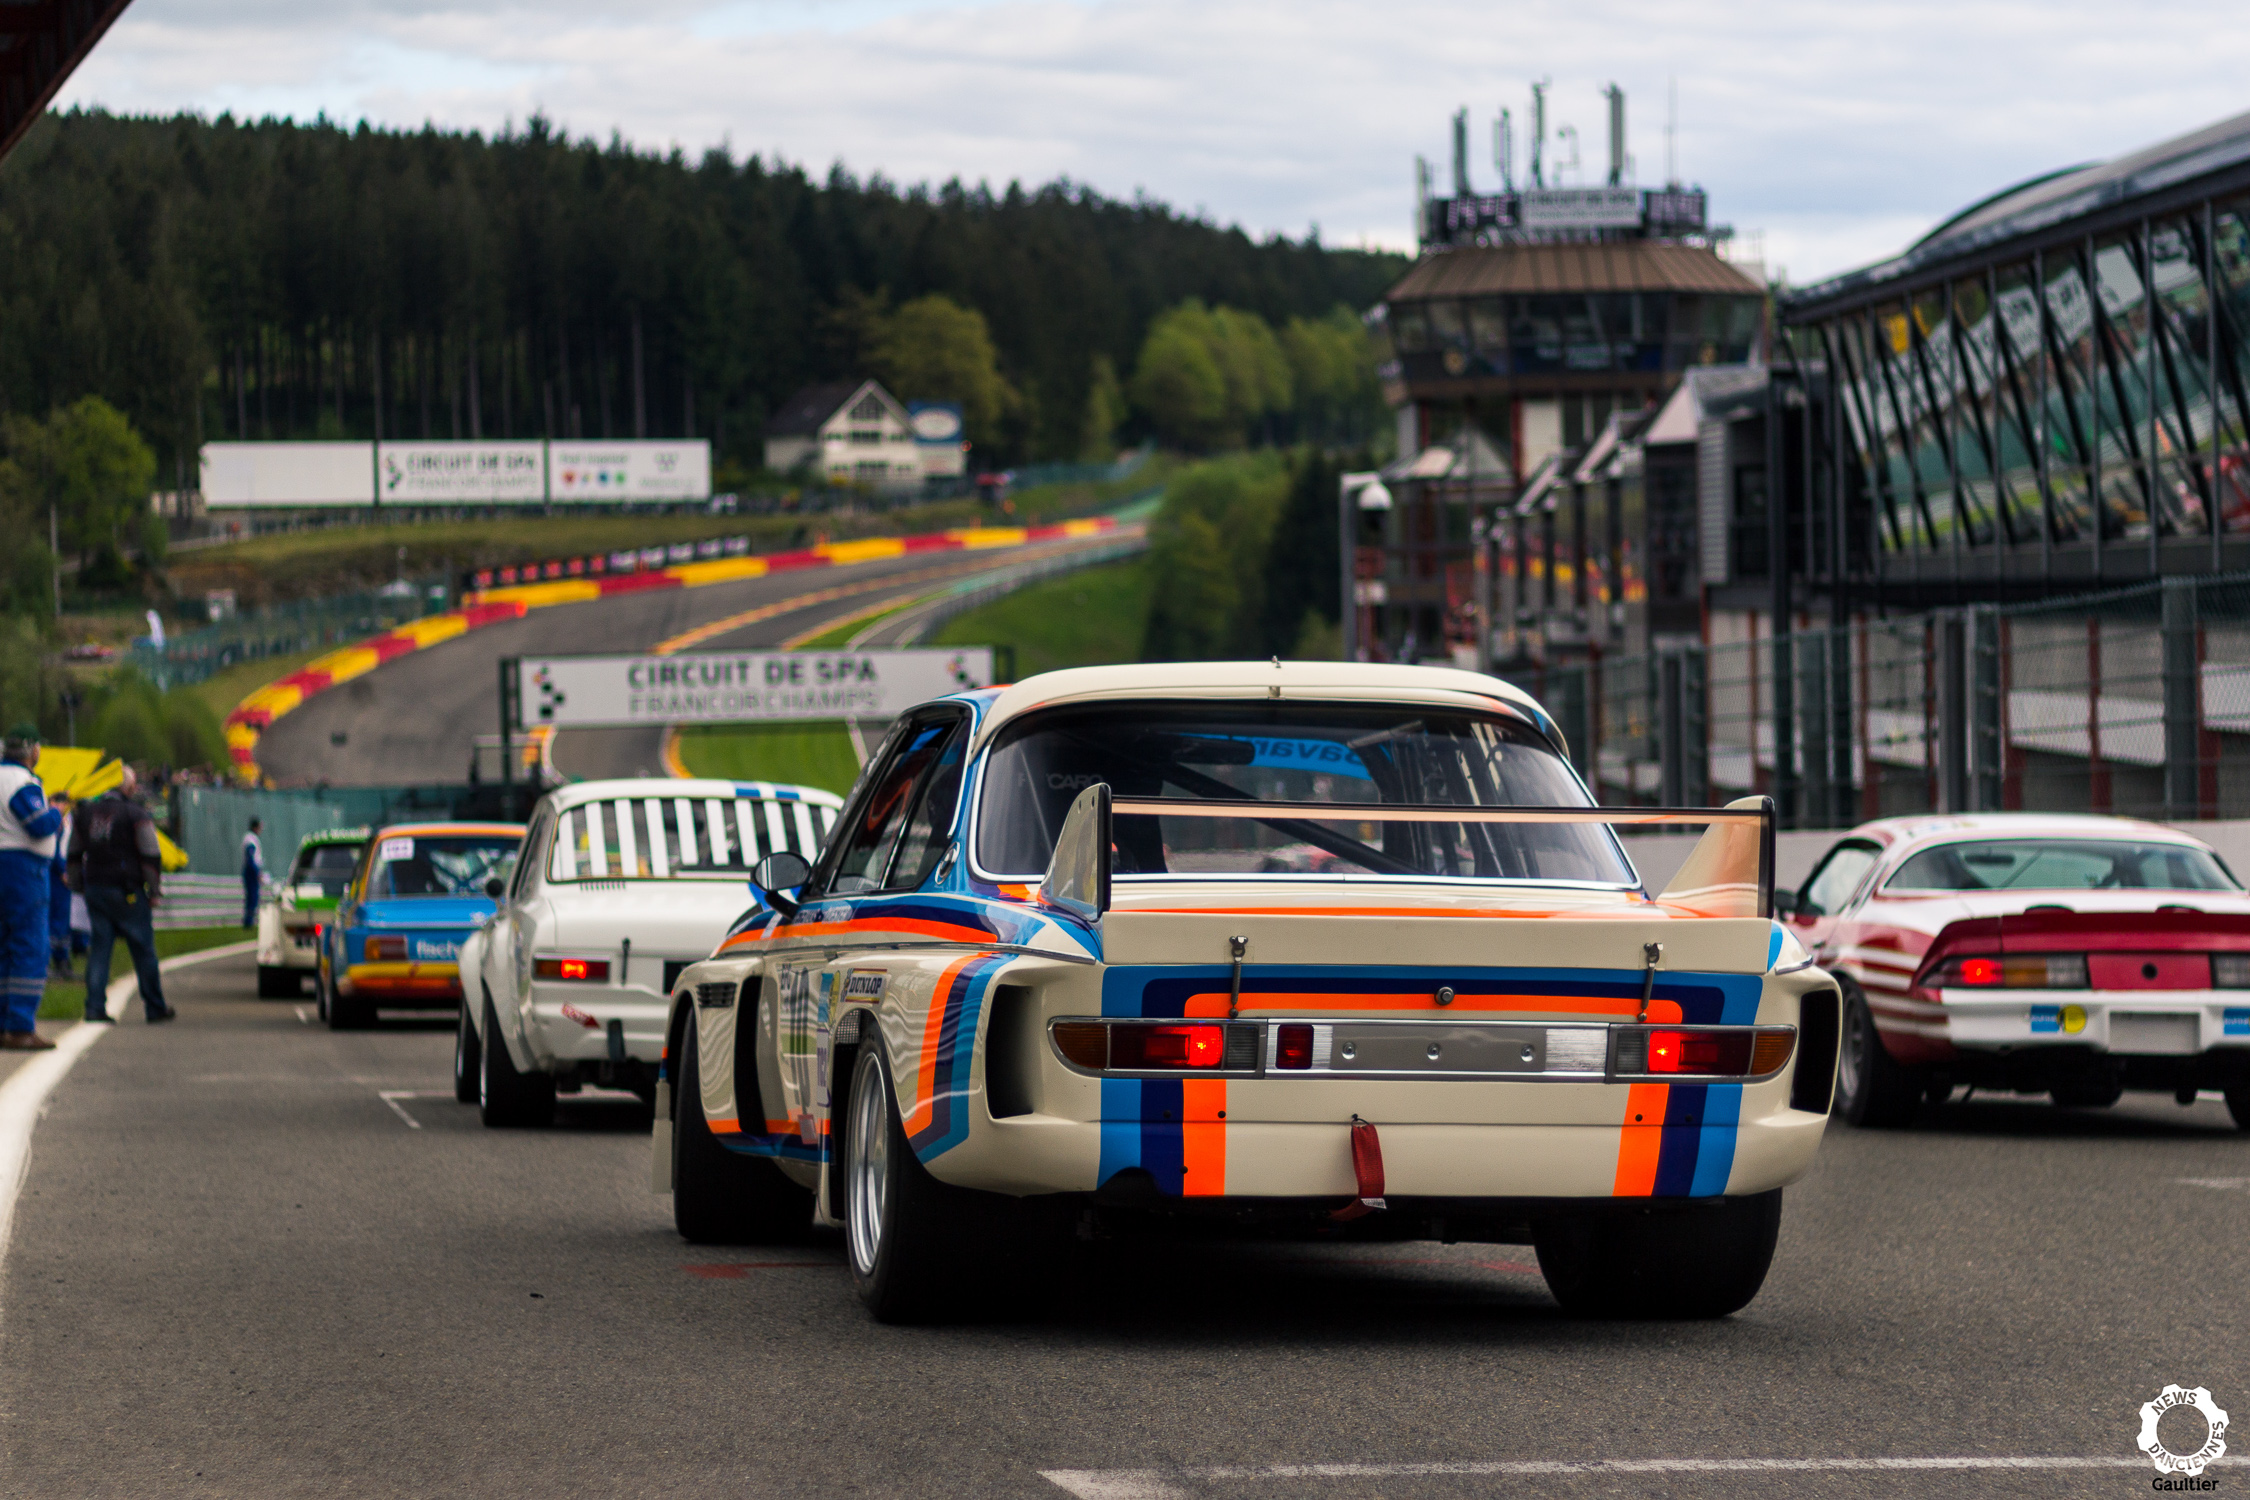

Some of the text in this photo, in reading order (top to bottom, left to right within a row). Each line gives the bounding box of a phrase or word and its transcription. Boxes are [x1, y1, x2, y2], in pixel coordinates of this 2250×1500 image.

[627, 657, 878, 690] CIRCUIT DE SPA
[629, 687, 884, 715] FRANCORCHAMPS
[848, 976, 883, 995] DUNLOP
